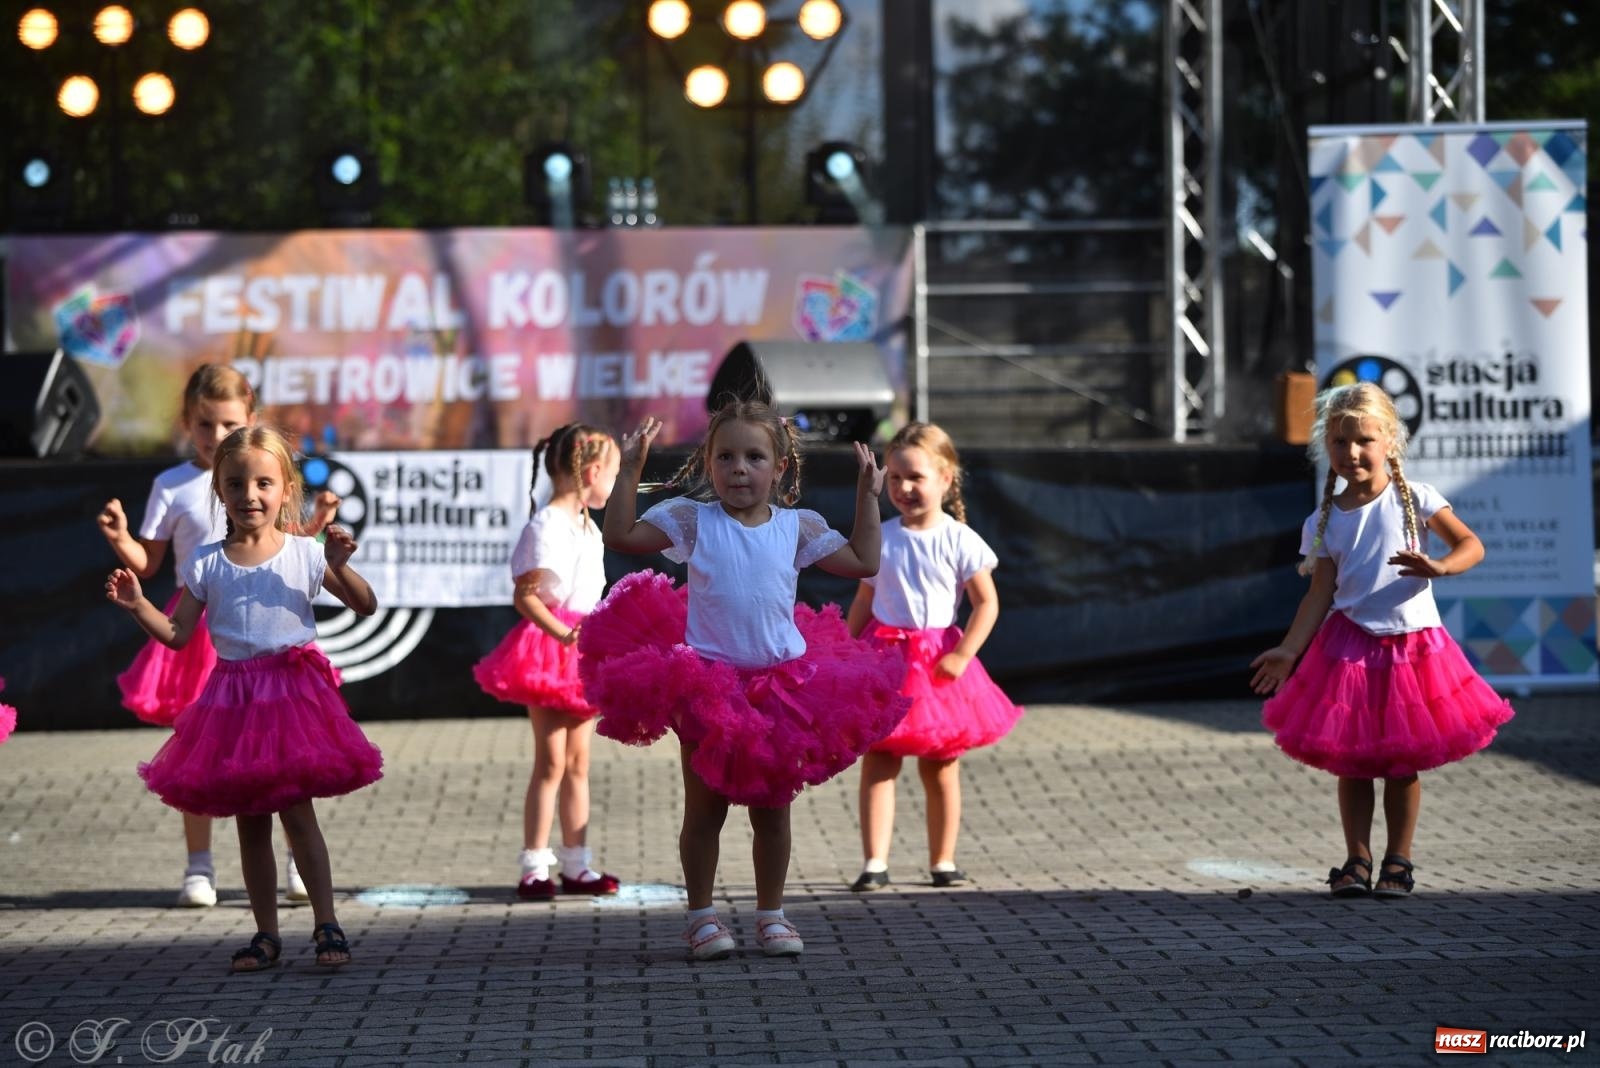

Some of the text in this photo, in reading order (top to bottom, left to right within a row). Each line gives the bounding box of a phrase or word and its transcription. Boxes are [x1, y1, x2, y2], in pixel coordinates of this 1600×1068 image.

[165, 252, 768, 334] FESTIWAL KOLORÓW
[234, 355, 520, 405] PIETROWICE
[1426, 354, 1537, 391] stacja
[1428, 392, 1563, 422] kultura
[374, 459, 483, 496] stacja
[374, 498, 509, 527] kultura
